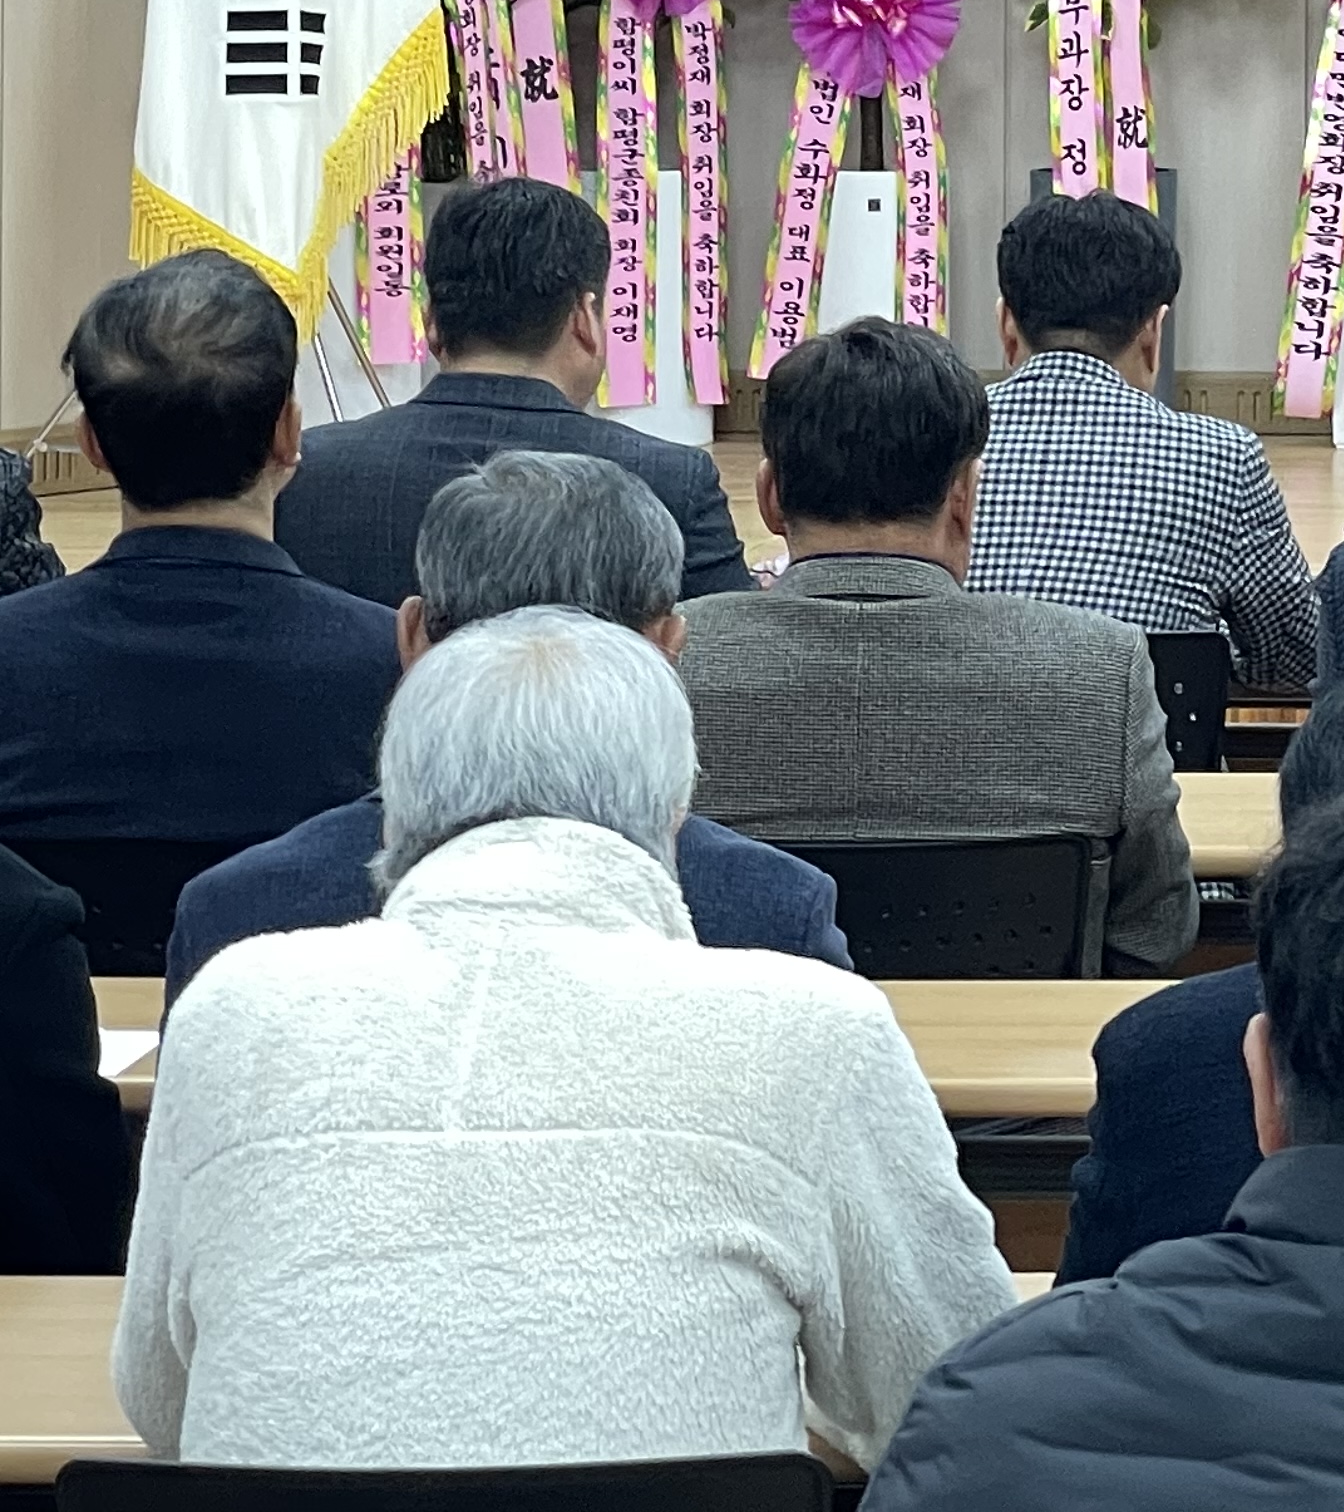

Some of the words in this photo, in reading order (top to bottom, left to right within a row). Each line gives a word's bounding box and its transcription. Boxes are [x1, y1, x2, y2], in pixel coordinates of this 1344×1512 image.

[684, 21, 712, 85] 박정재
[689, 99, 717, 143] 회장
[902, 114, 929, 158] 회장
[692, 154, 717, 222] 취임을
[907, 170, 936, 237] 취임을
[1303, 181, 1344, 248] 취임을
[613, 238, 642, 272] 회장
[783, 224, 811, 263] 대표
[610, 282, 638, 343] 이재영
[693, 233, 720, 342] 축하합니다
[766, 277, 805, 350] 이용범
[1292, 252, 1342, 361] 축하합니다
